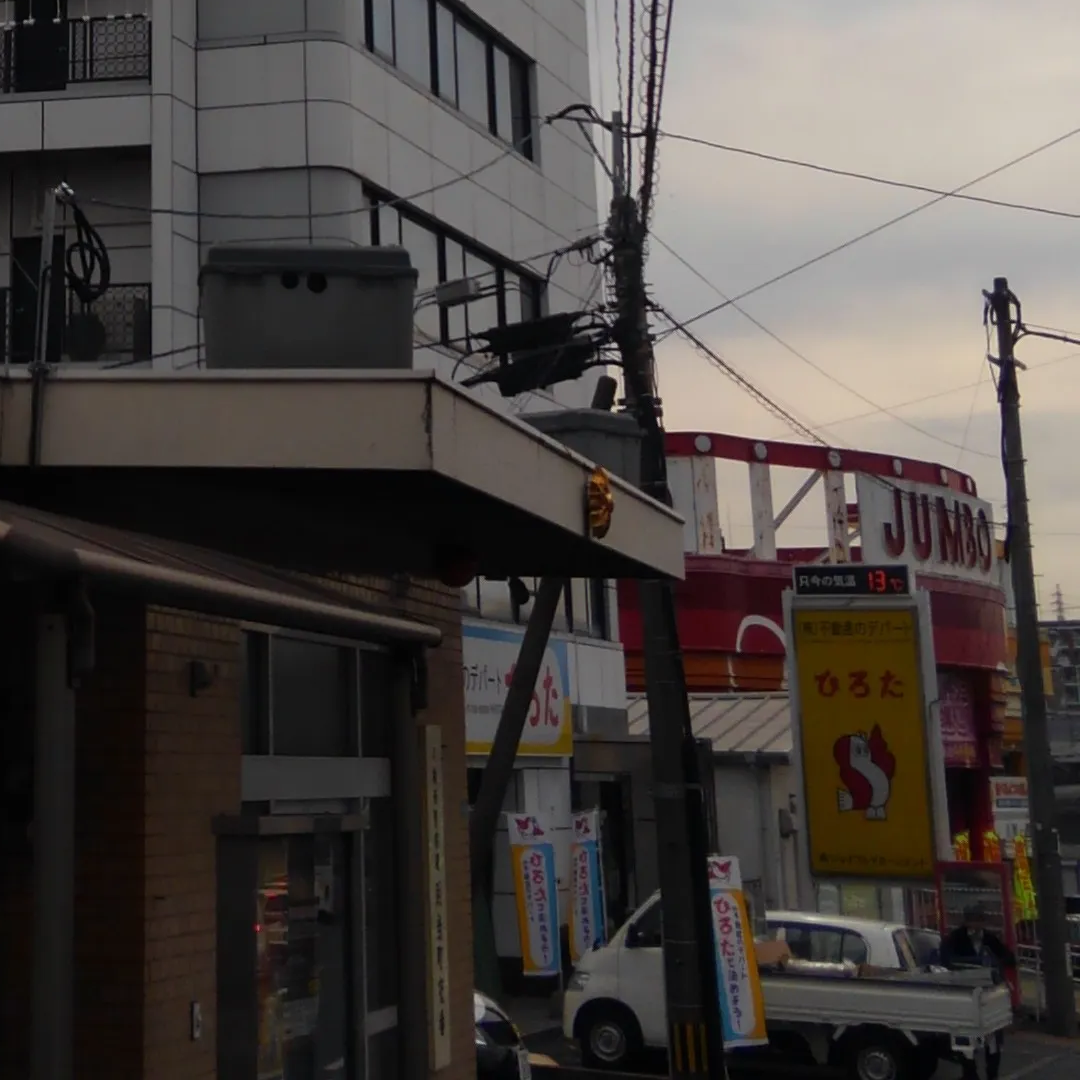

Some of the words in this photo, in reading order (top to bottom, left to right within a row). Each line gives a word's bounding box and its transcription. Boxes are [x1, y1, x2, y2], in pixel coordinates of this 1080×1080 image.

[883, 488, 993, 575] JUMBO
[813, 668, 905, 701] ひろた
